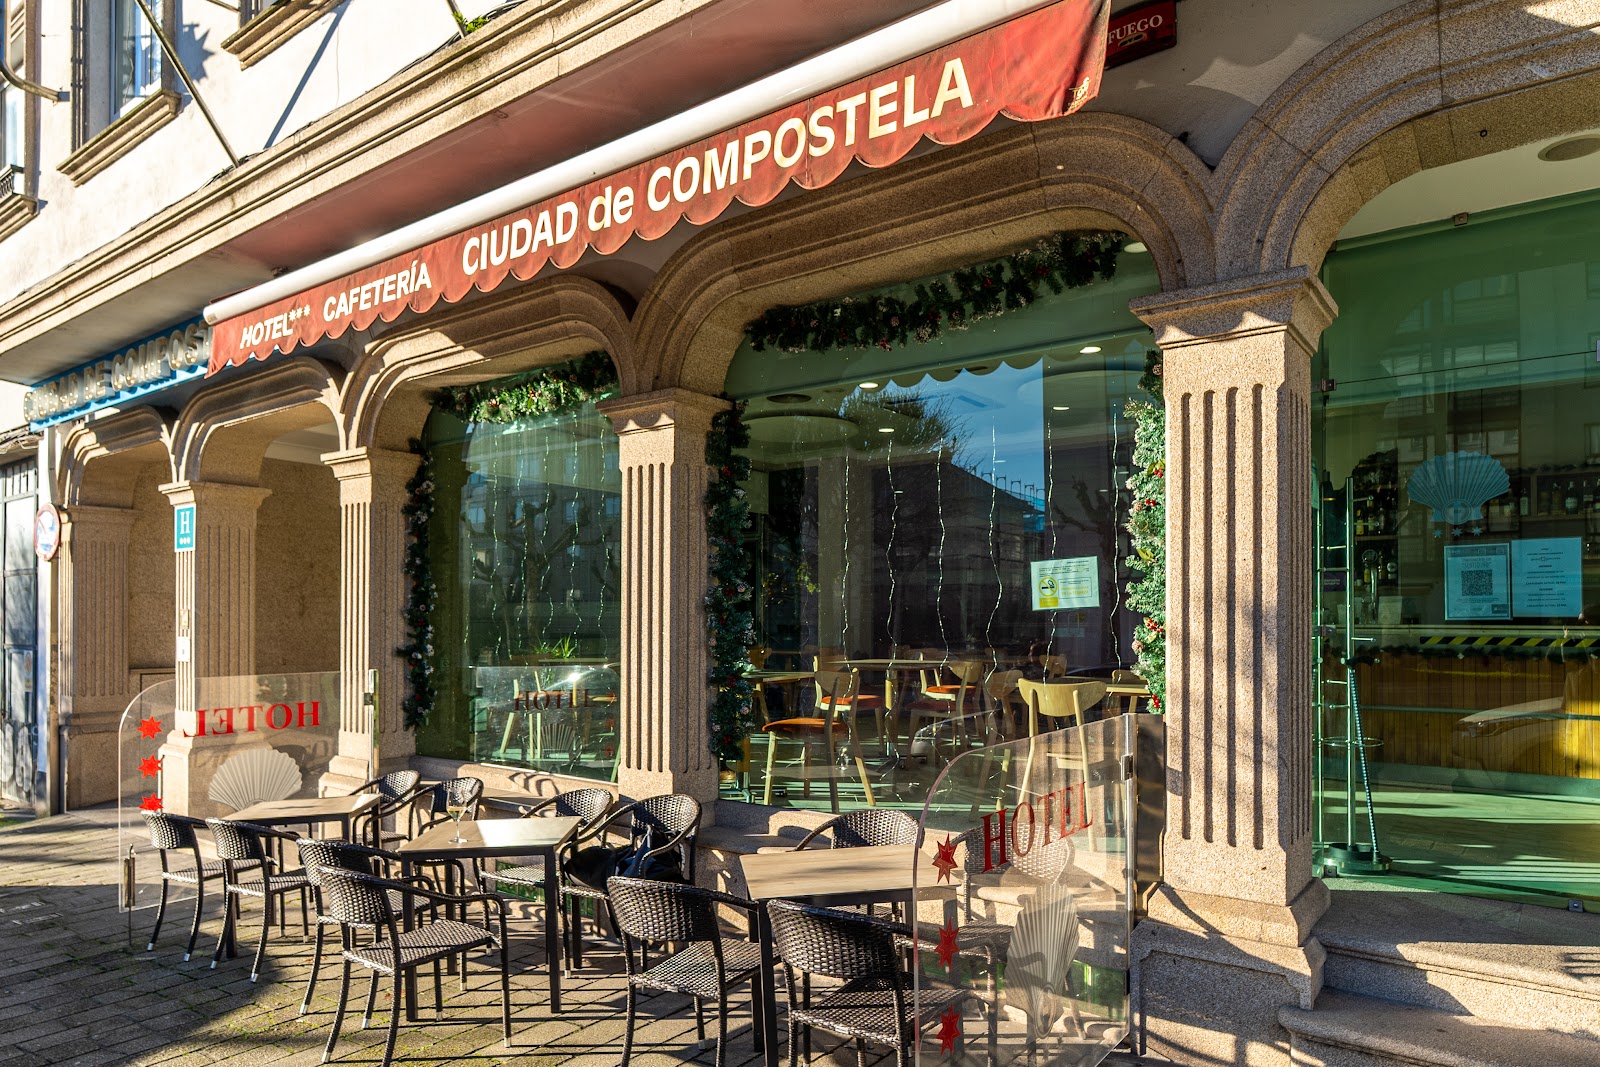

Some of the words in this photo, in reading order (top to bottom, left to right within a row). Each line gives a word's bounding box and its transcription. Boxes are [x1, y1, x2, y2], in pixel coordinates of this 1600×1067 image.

[1108, 14, 1163, 45] FUEGO
[323, 260, 433, 322] CAFETERÍA
[462, 202, 579, 276] CIUDAD
[587, 185, 634, 232] de
[646, 57, 975, 213] COMPOSTELA
[83, 361, 108, 400] DE
[180, 511, 190, 534] H
[980, 782, 1094, 874] HOTEL
